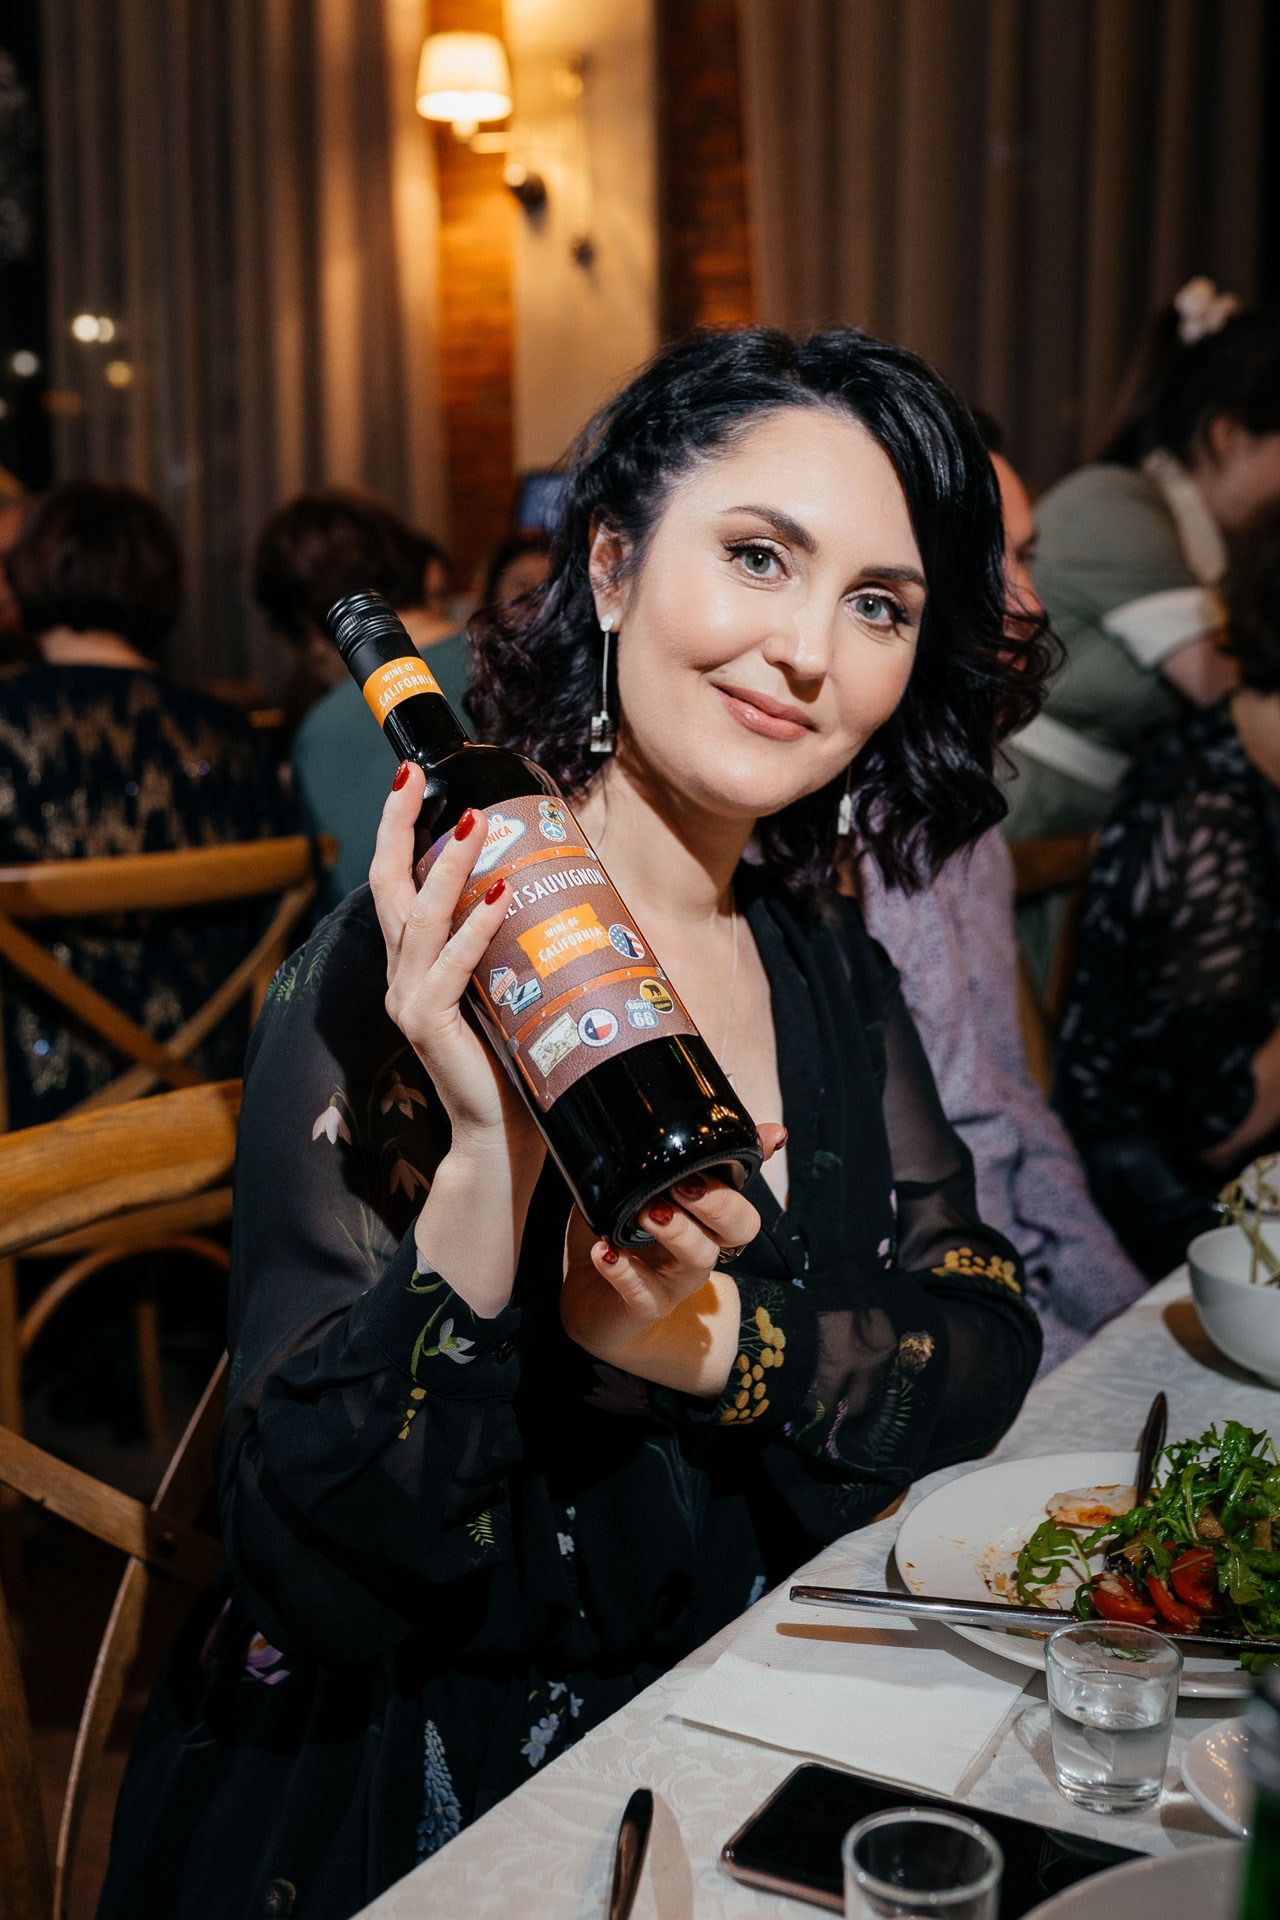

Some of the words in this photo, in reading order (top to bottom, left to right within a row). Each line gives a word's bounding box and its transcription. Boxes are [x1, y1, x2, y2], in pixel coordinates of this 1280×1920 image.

[382, 666, 403, 682] WINE
[405, 663, 414, 671] OF
[379, 675, 433, 707] CALIFORNIA
[522, 868, 606, 904] SAUVIGNON
[543, 921, 568, 938] WINE
[567, 916, 579, 927] OF
[538, 926, 602, 962] CALIFORNIA
[627, 1001, 652, 1011] ROUTE
[633, 1011, 656, 1027] 66
